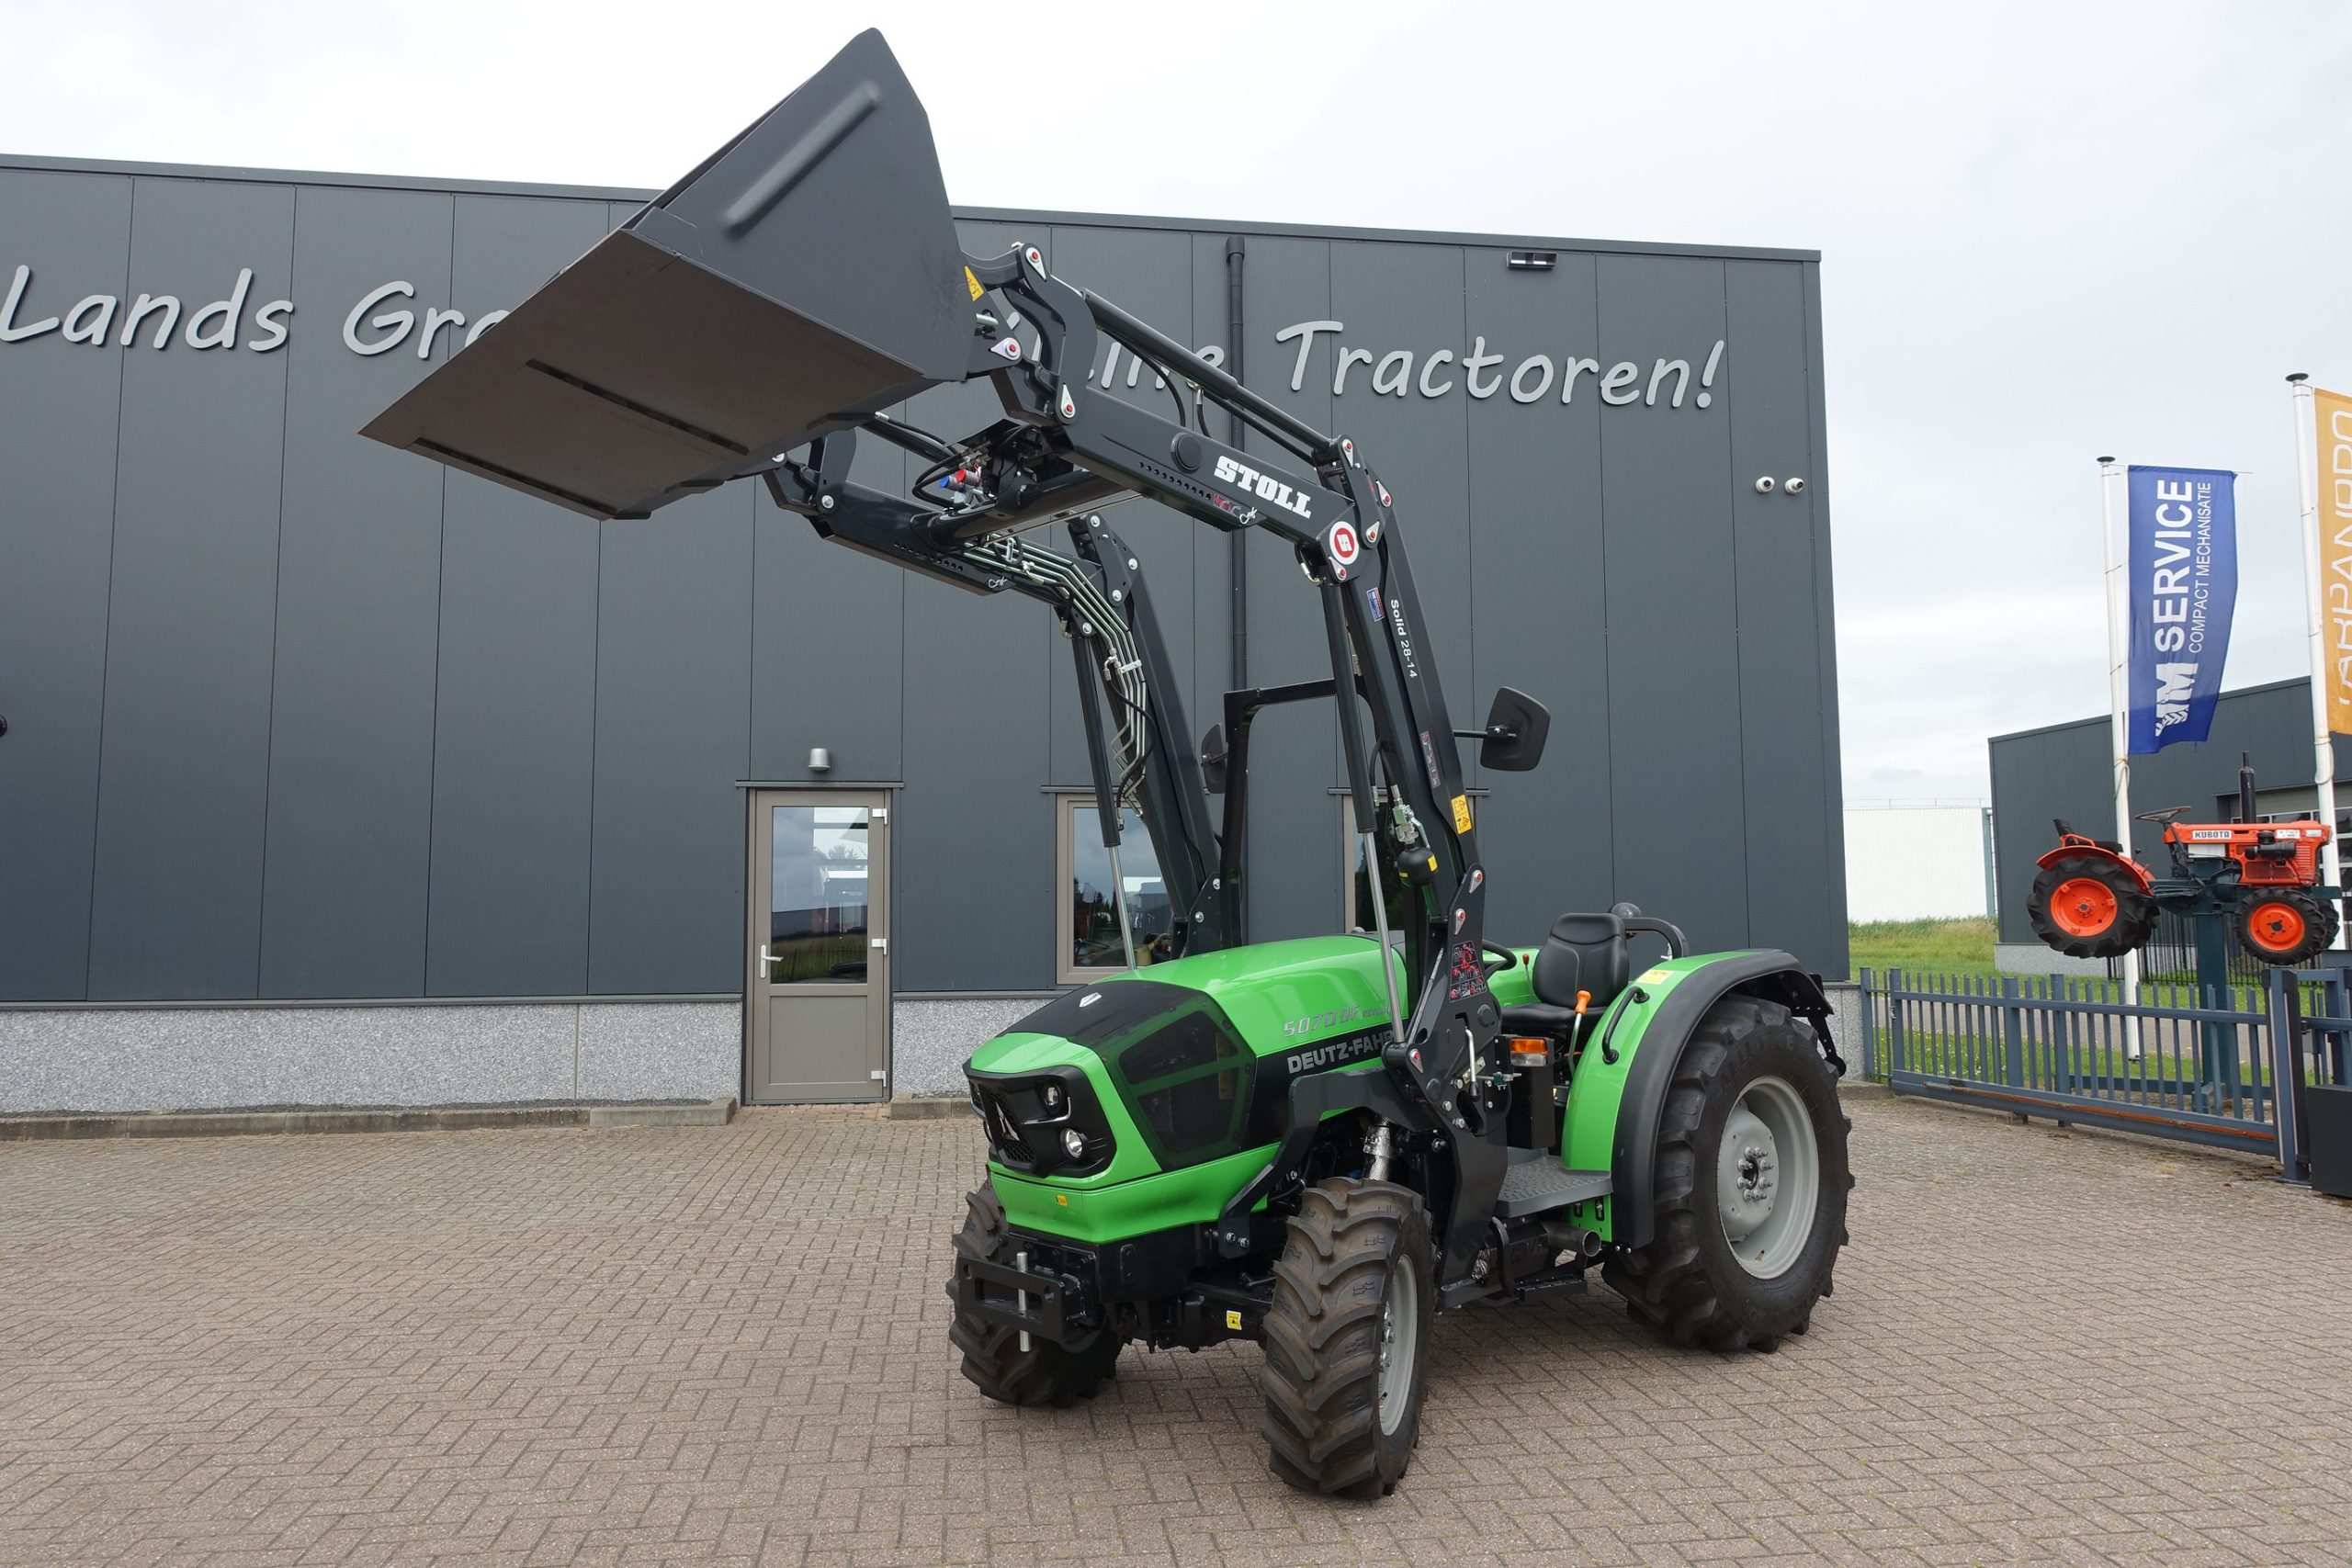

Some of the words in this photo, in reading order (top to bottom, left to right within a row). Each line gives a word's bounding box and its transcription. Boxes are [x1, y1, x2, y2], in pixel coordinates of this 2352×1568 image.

[0, 265, 294, 353] Lands
[1275, 320, 1725, 409] Tractoren!
[1214, 456, 1312, 519] STOLL
[2153, 479, 2193, 653] SERVICE
[2195, 482, 2211, 577] MECHANISATIE
[1390, 599, 1407, 636] Solid
[1400, 640, 1418, 678] 28-14
[2188, 580, 2210, 654] COMPACT
[2194, 830, 2230, 839] KUBOTA
